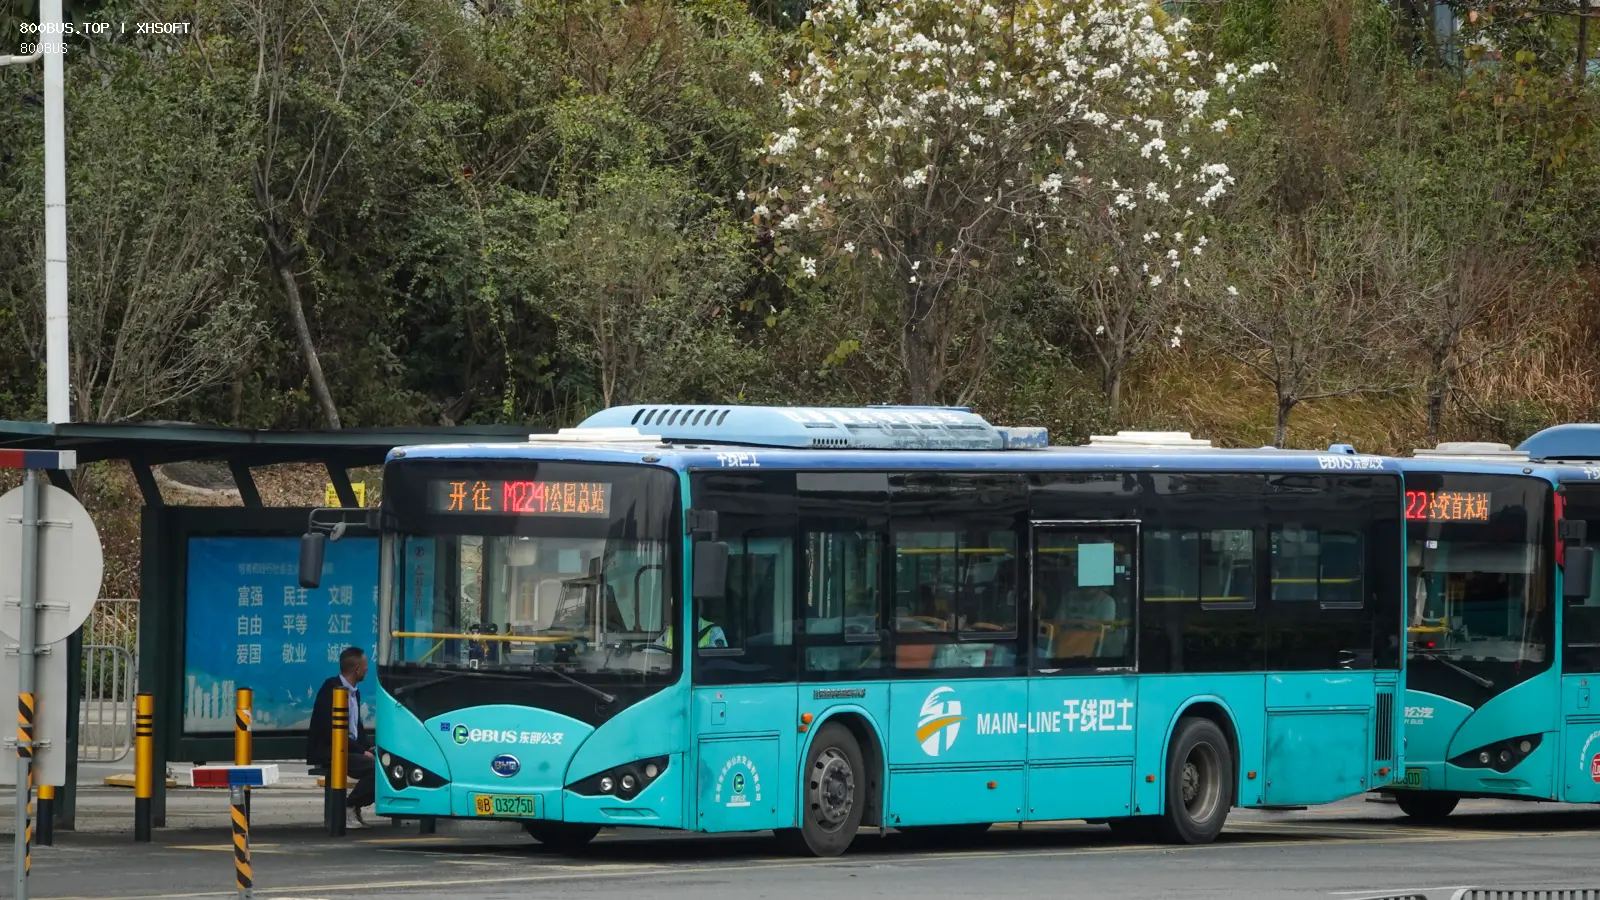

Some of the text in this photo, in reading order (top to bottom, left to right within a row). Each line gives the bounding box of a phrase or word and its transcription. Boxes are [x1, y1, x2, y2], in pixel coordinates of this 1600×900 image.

[1318, 456, 1352, 469] eBUS
[448, 481, 605, 514] 开往 M224 公园总站
[238, 585, 263, 607] 富强
[283, 585, 308, 607] 民主
[328, 585, 353, 605] 文明
[237, 614, 262, 636] 自由
[282, 614, 308, 635] 平等
[327, 614, 352, 634] 公正
[236, 643, 262, 664] 爱国
[281, 643, 307, 664] 敬业
[977, 698, 1134, 735] MAIN-LINE 干线巴士
[470, 728, 564, 745] eBUS 东部公交
[494, 760, 517, 770] BYD
[495, 798, 533, 813] 03275D
